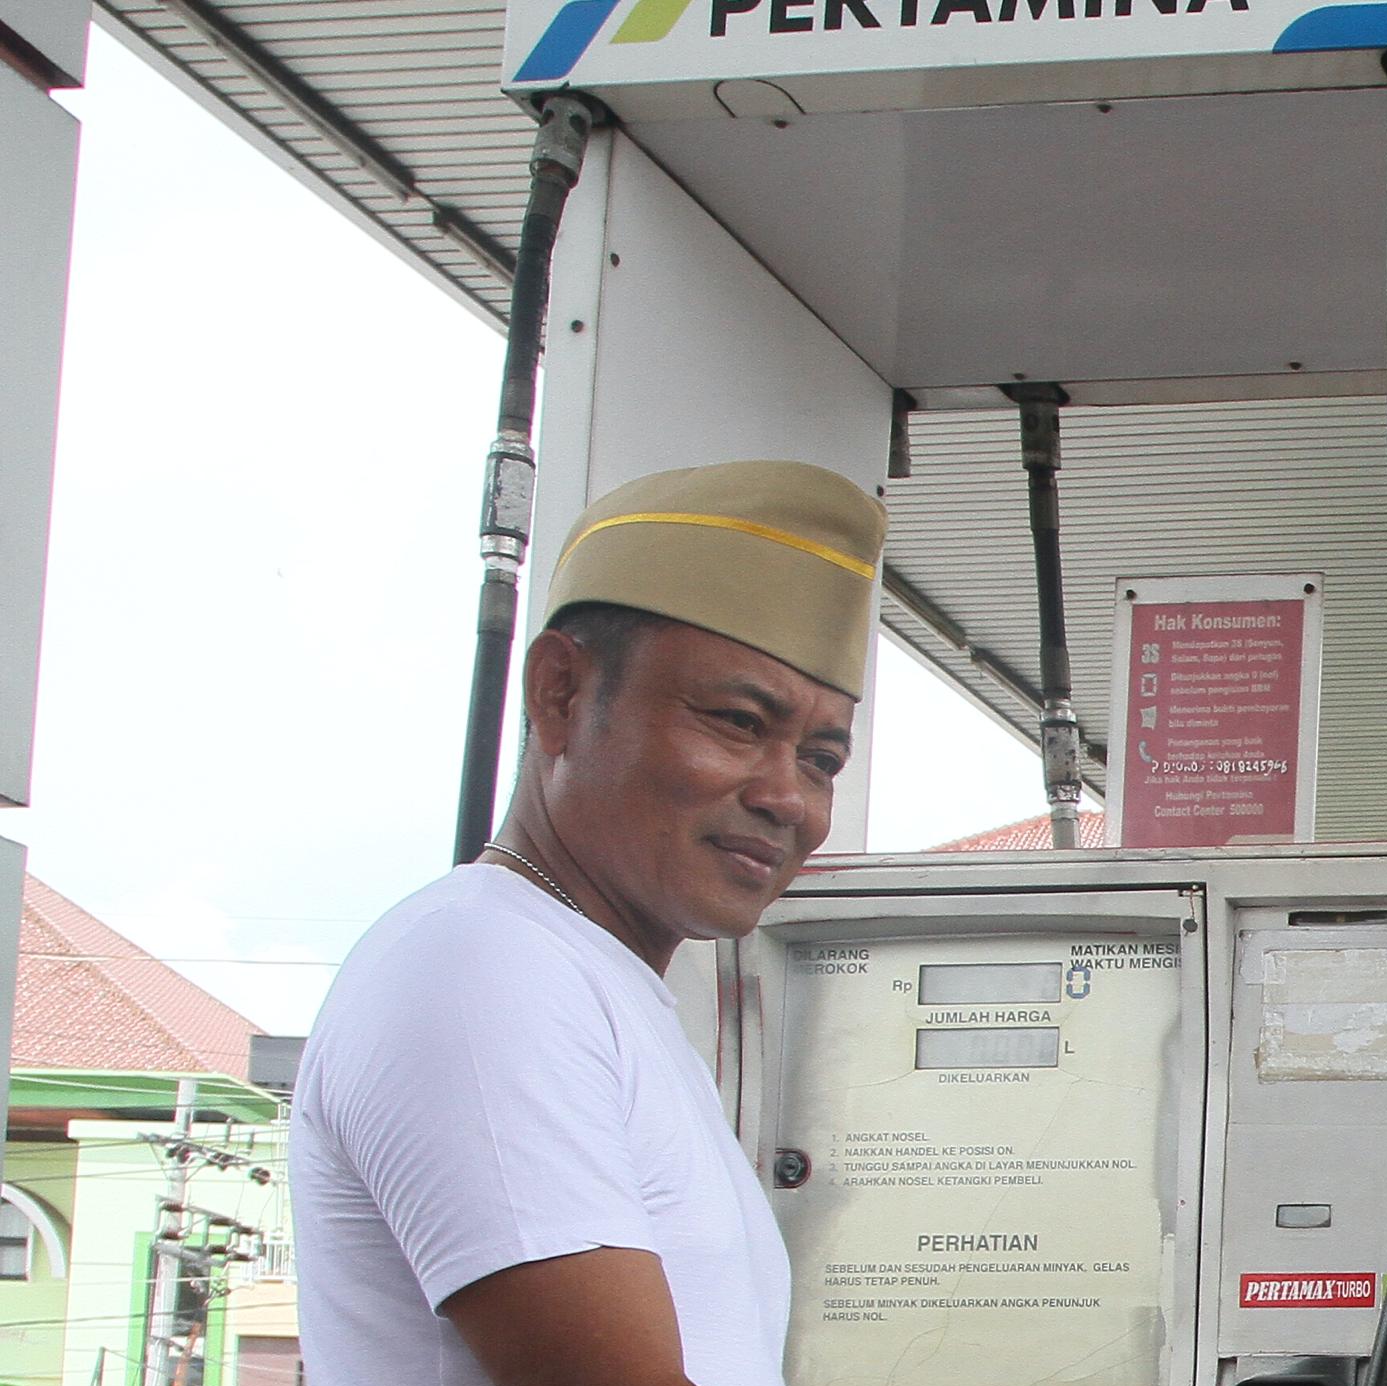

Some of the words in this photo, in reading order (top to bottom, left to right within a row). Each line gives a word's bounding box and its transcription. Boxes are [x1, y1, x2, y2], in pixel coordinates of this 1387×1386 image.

[1154, 614, 1186, 631] Hak
[1192, 614, 1281, 630] Konsumen:
[1071, 945, 1138, 956] MATIKAN
[1071, 958, 1124, 970] WAKTU
[892, 979, 913, 993] Rp
[925, 1011, 990, 1025] JUMLAH
[994, 1010, 1052, 1024] HARGA
[1064, 1041, 1075, 1054] L
[938, 1072, 1030, 1084] DIKELUARKAN
[845, 1133, 889, 1142] ANGKAT
[844, 1147, 892, 1157] NAIKKAN
[895, 1147, 939, 1157] HANDEL
[942, 1147, 956, 1156] KE
[959, 1146, 995, 1156] POSISI
[843, 1162, 890, 1172] TUNGGU
[891, 1161, 932, 1172] SAMPAI
[934, 1161, 973, 1171] ANGKA
[975, 1161, 986, 1171] DI
[988, 1160, 1023, 1171] LAYAR
[1026, 1160, 1109, 1171] MENUNJUKKAN
[843, 1176, 896, 1187] ARAHKAN
[897, 1176, 934, 1186] NOSEL
[936, 1176, 991, 1186] KETANGKI
[917, 1234, 1039, 1252] PERHATIAN
[825, 1263, 876, 1274] SEBELUM
[879, 1263, 902, 1273] DAN
[904, 1263, 956, 1273] SESUDAH
[958, 1263, 1040, 1273] PENGELUARAN
[1042, 1263, 1088, 1272] MINYAK.
[1092, 1262, 1130, 1272] GELAS
[824, 1276, 861, 1286] HARUS
[864, 1276, 900, 1286] TETAP
[902, 1276, 940, 1286] PENUH.
[823, 1299, 875, 1308] SEBELUM
[877, 1298, 918, 1308] MINYAK
[920, 1298, 999, 1308] DIKELUARKAN
[1001, 1297, 1039, 1308] ANGKA
[1041, 1297, 1101, 1308] PENUNJUK
[823, 1312, 860, 1322] HARUS
[862, 1312, 888, 1321] NOL.
